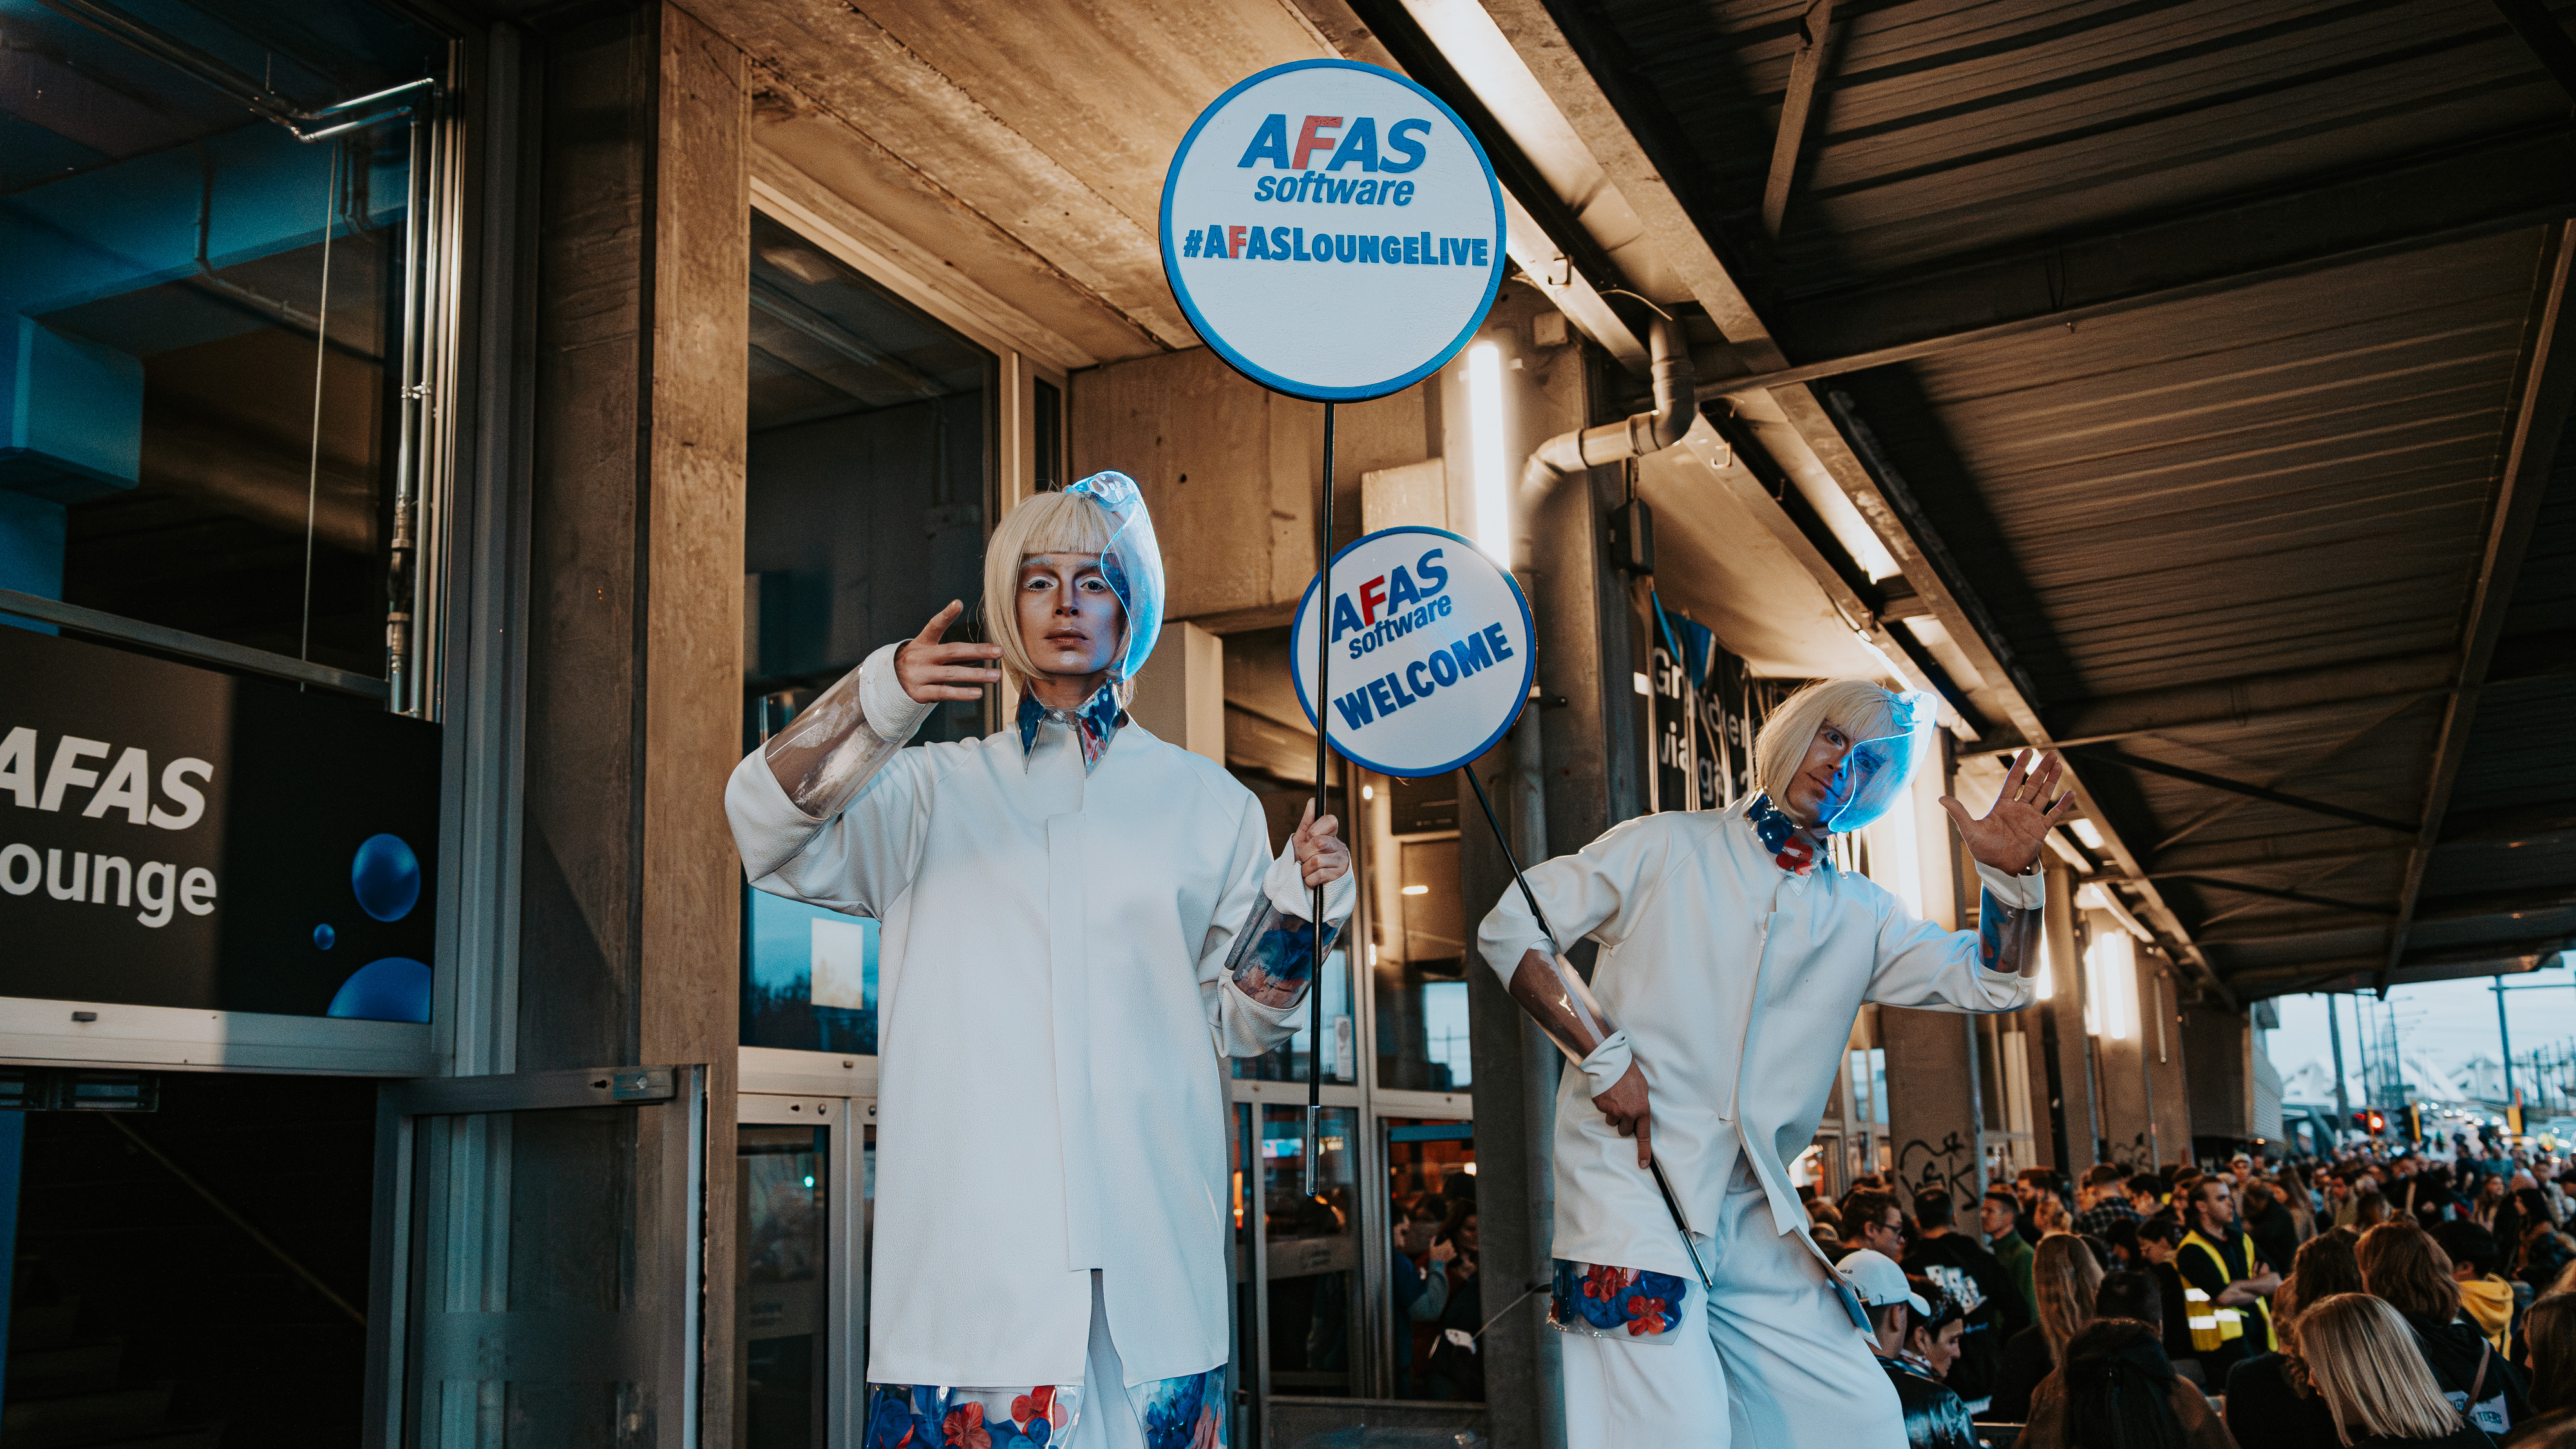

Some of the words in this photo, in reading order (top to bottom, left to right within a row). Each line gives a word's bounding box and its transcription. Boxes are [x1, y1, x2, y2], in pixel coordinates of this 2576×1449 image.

[1237, 113, 1432, 173] AFAS
[1254, 171, 1414, 206] software
[1331, 548, 1448, 643] AFAS
[1349, 594, 1452, 659] software
[1333, 622, 1513, 730] WELCOME
[0, 726, 214, 831] AFAS
